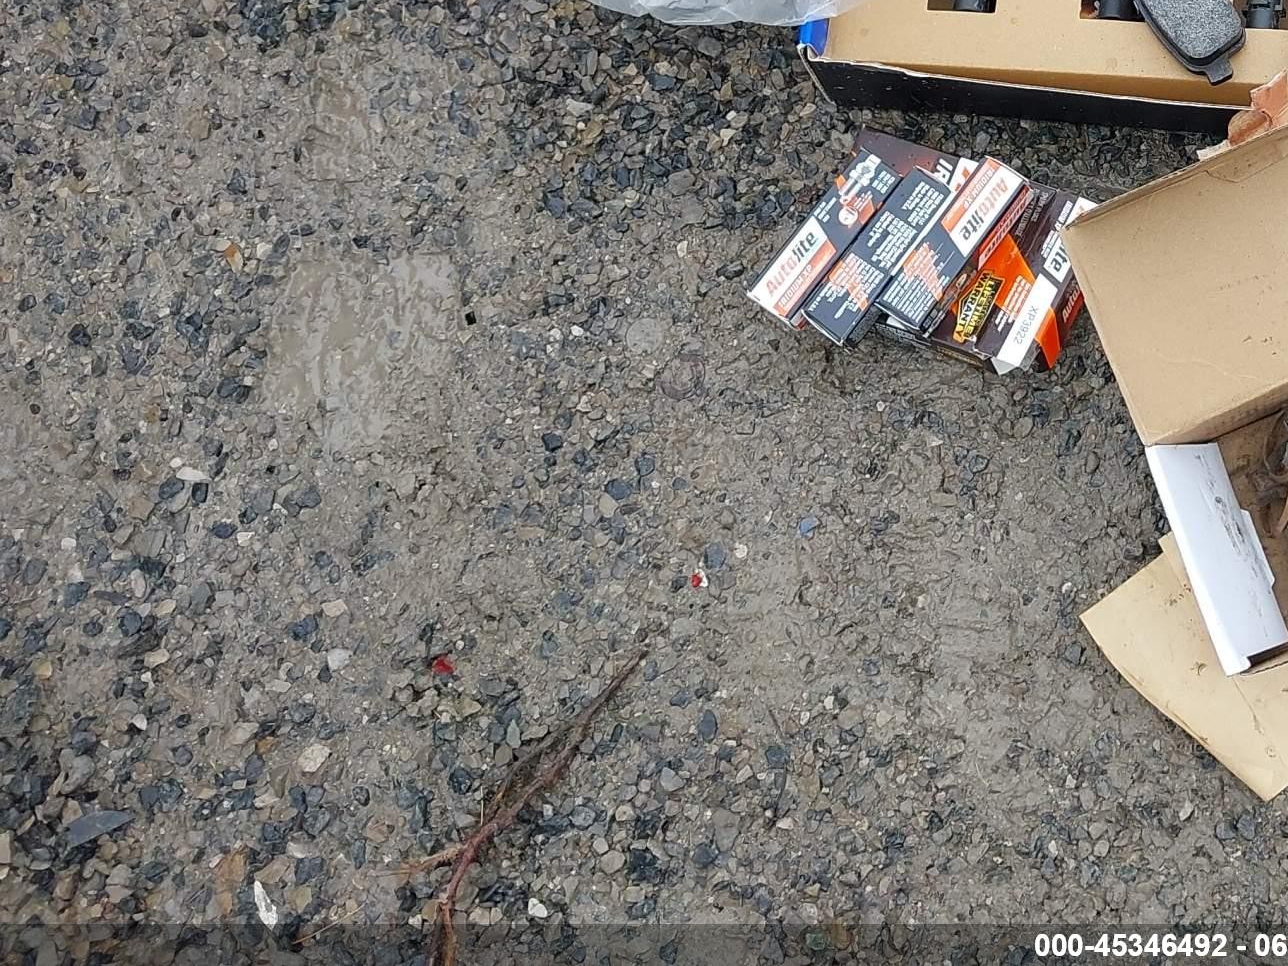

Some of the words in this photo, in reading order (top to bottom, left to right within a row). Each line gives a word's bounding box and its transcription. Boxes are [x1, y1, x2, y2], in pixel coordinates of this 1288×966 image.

[958, 177, 1007, 241] Autolite
[767, 230, 818, 297] Autolite
[956, 273, 990, 337] WARRANTY
[964, 280, 995, 334] LIFETIME
[1012, 304, 1039, 346] XP3922
